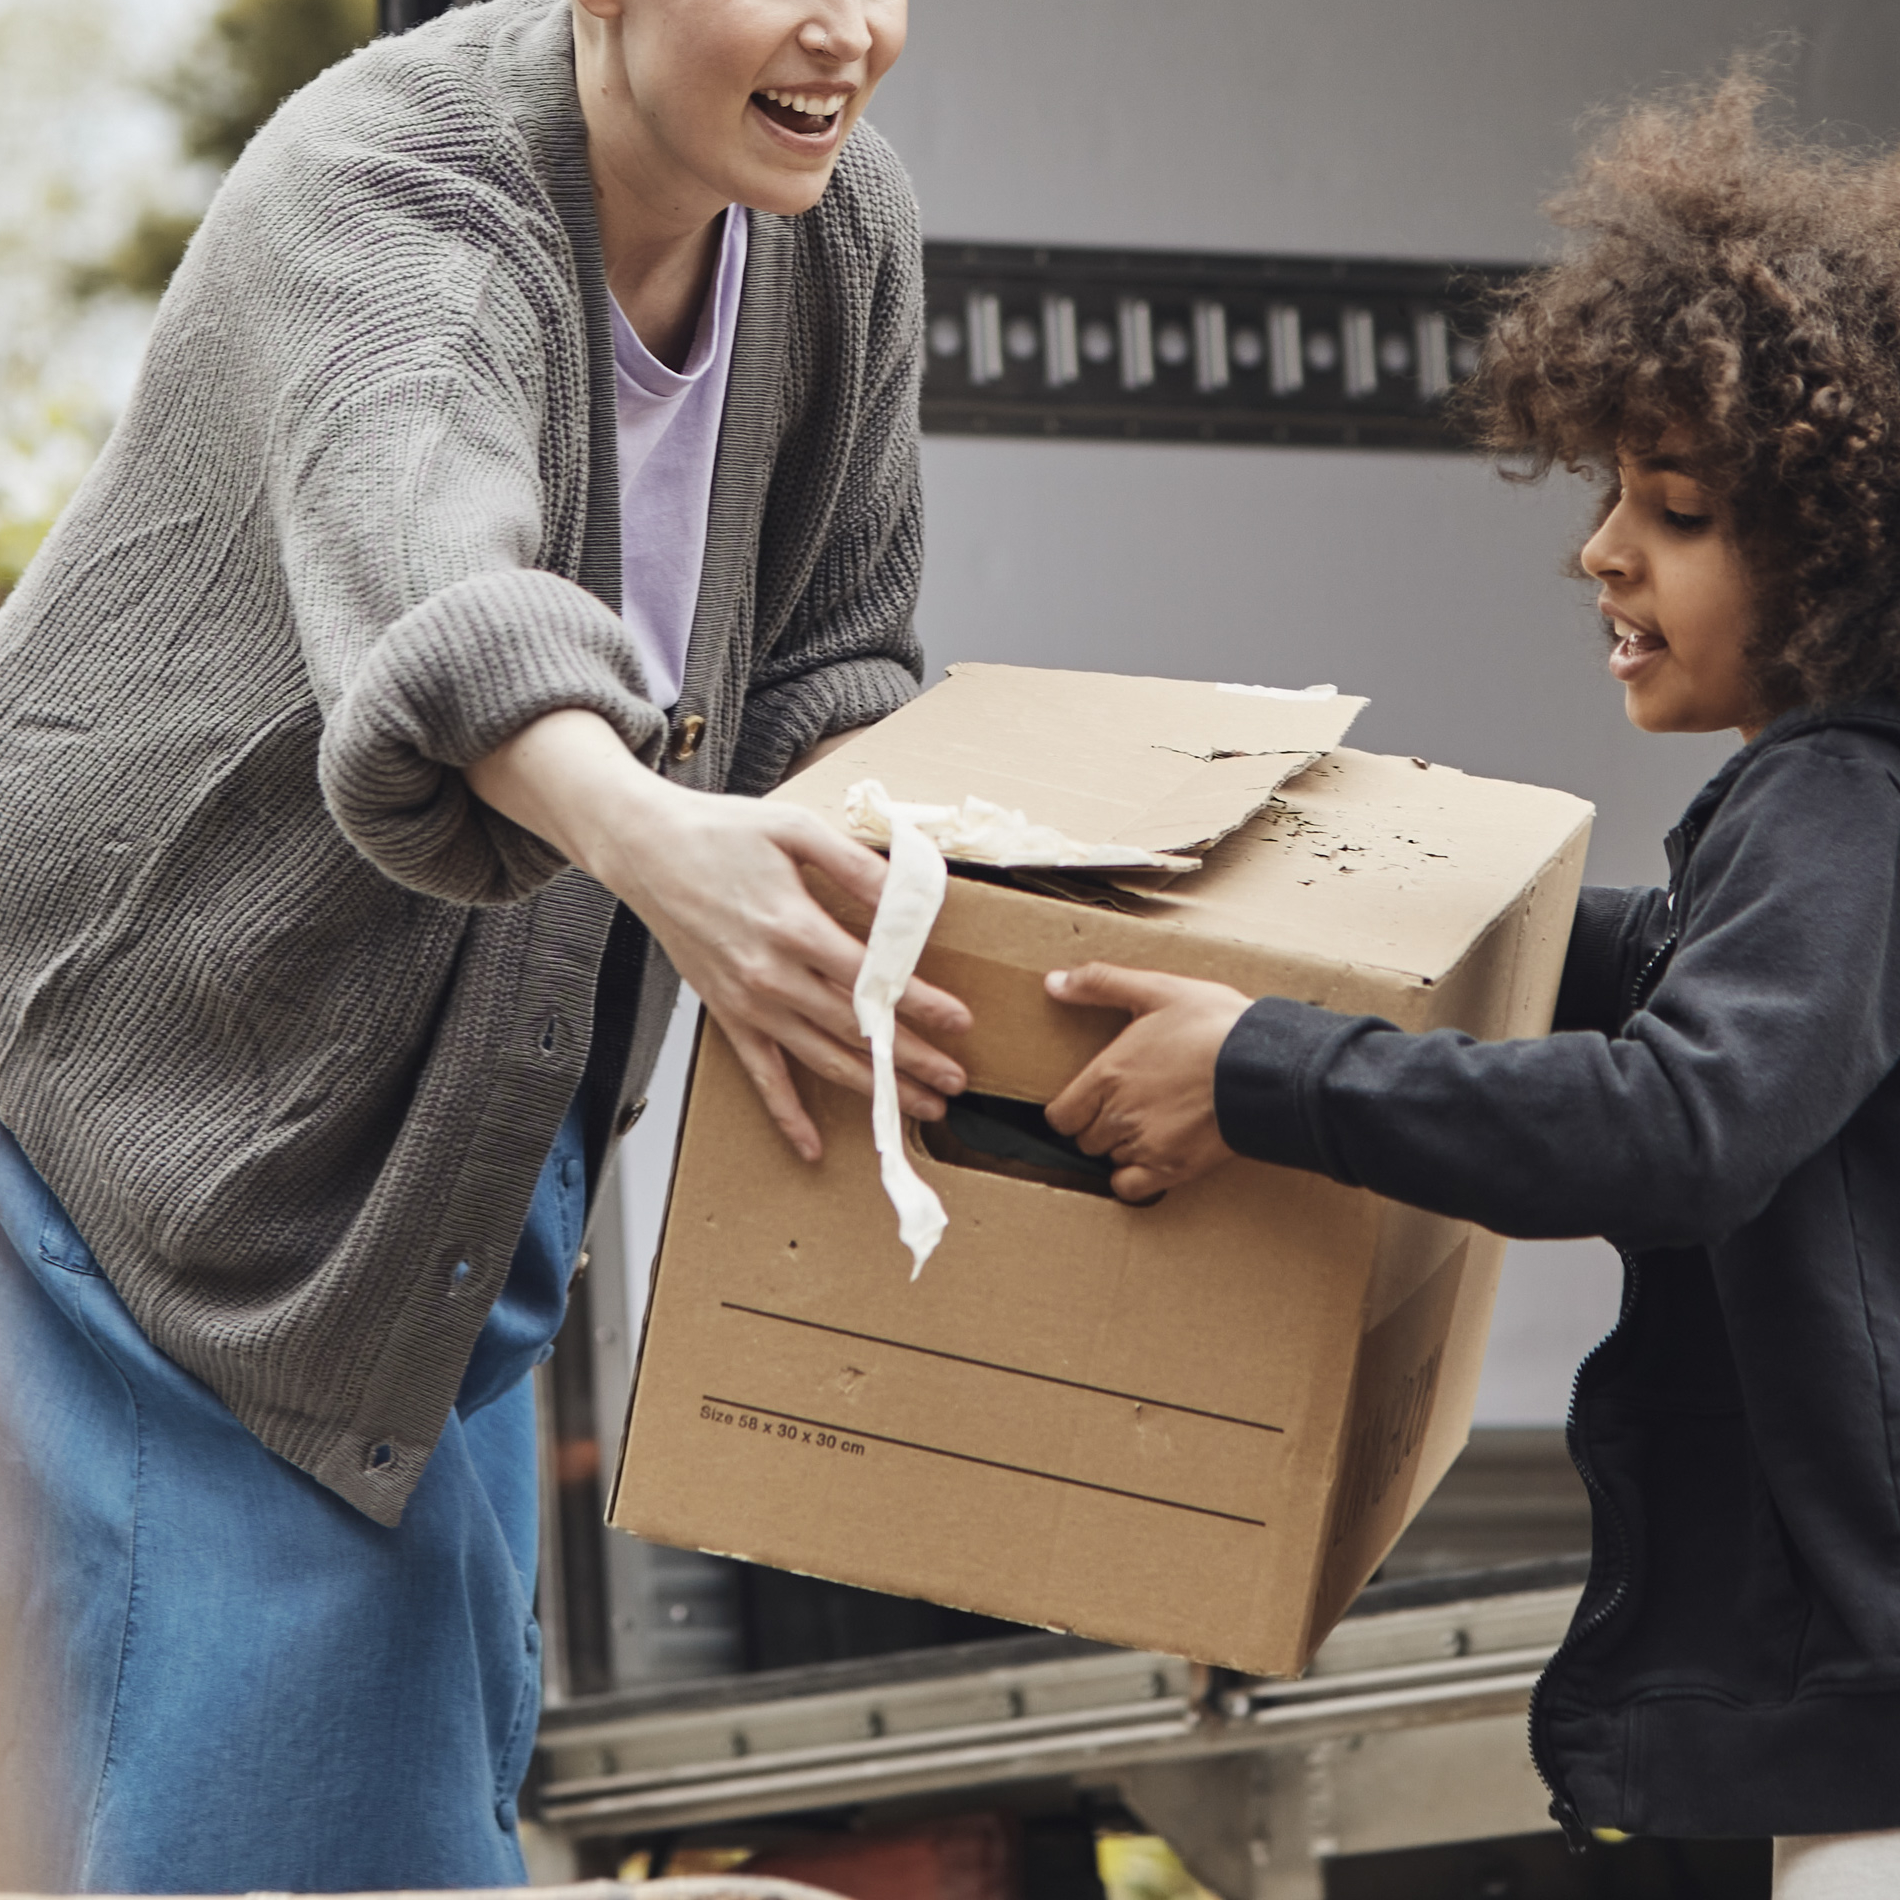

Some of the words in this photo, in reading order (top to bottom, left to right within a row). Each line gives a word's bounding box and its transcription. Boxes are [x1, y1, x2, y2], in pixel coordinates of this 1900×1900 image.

[700, 1405, 733, 1425] Size
[738, 1415, 759, 1431] 58
[762, 1422, 773, 1435] x
[777, 1423, 798, 1440] 30
[801, 1431, 813, 1444] x
[816, 1432, 837, 1449] 30
[840, 1440, 866, 1456] cm
